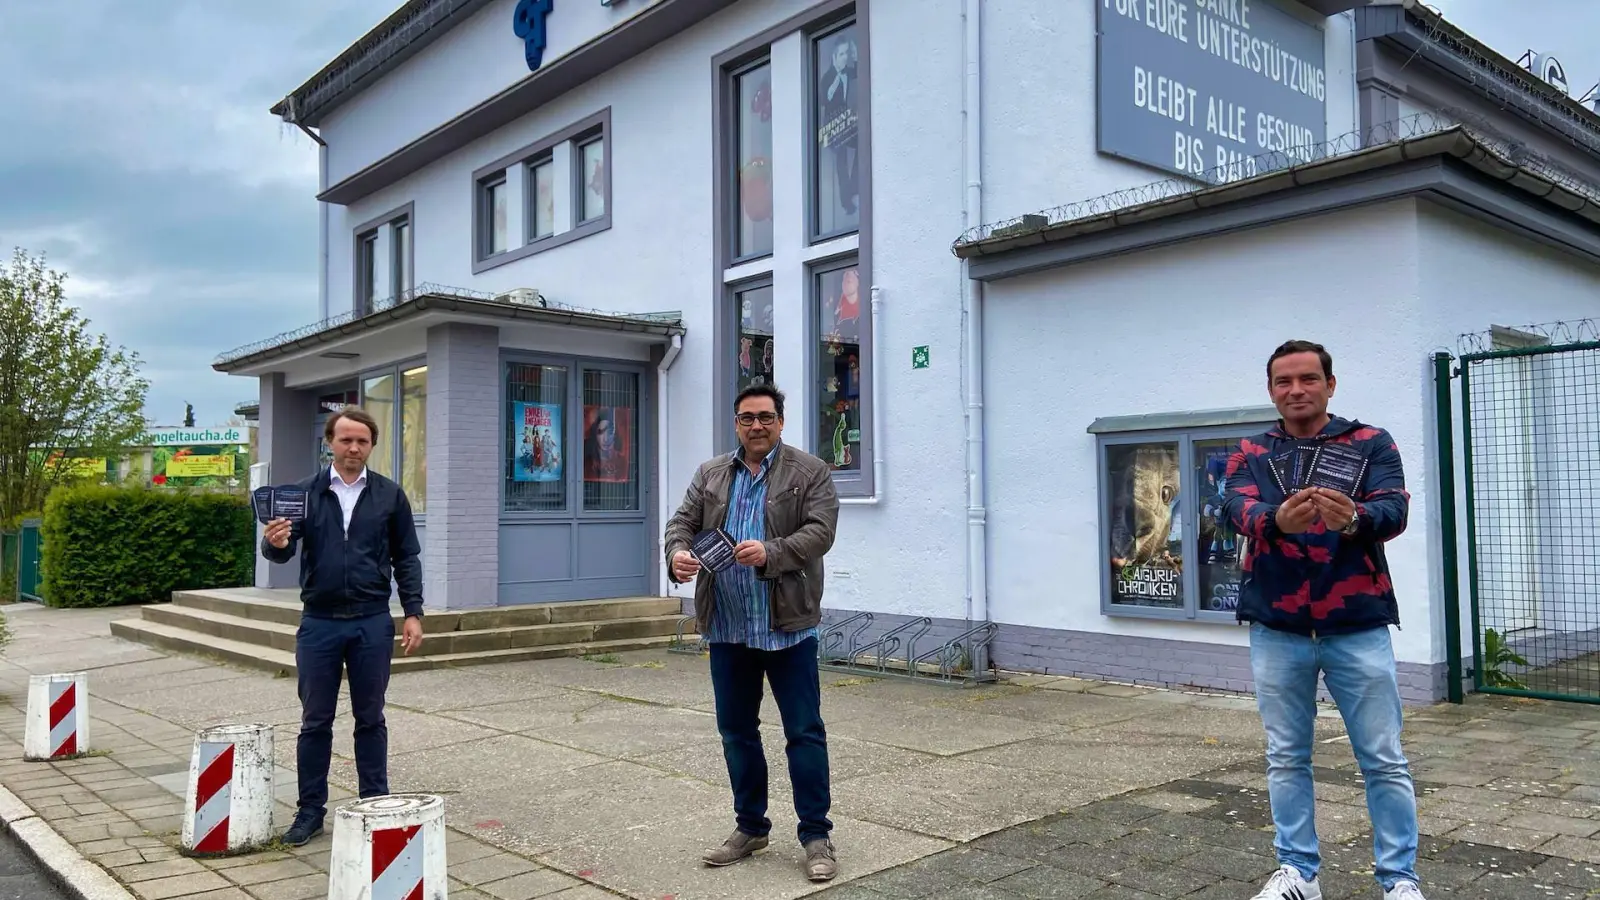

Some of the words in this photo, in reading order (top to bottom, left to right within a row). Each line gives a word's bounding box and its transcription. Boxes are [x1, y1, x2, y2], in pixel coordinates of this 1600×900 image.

[1196, 0, 1250, 30] NKE
[1145, 0, 1188, 43] EURE
[1196, 11, 1325, 102] UNTERSTÜTZUNG
[1134, 66, 1197, 127] BLEIBT
[1206, 96, 1246, 143] ALLE
[1256, 112, 1313, 163] GESUND
[1174, 131, 1203, 176] BIS
